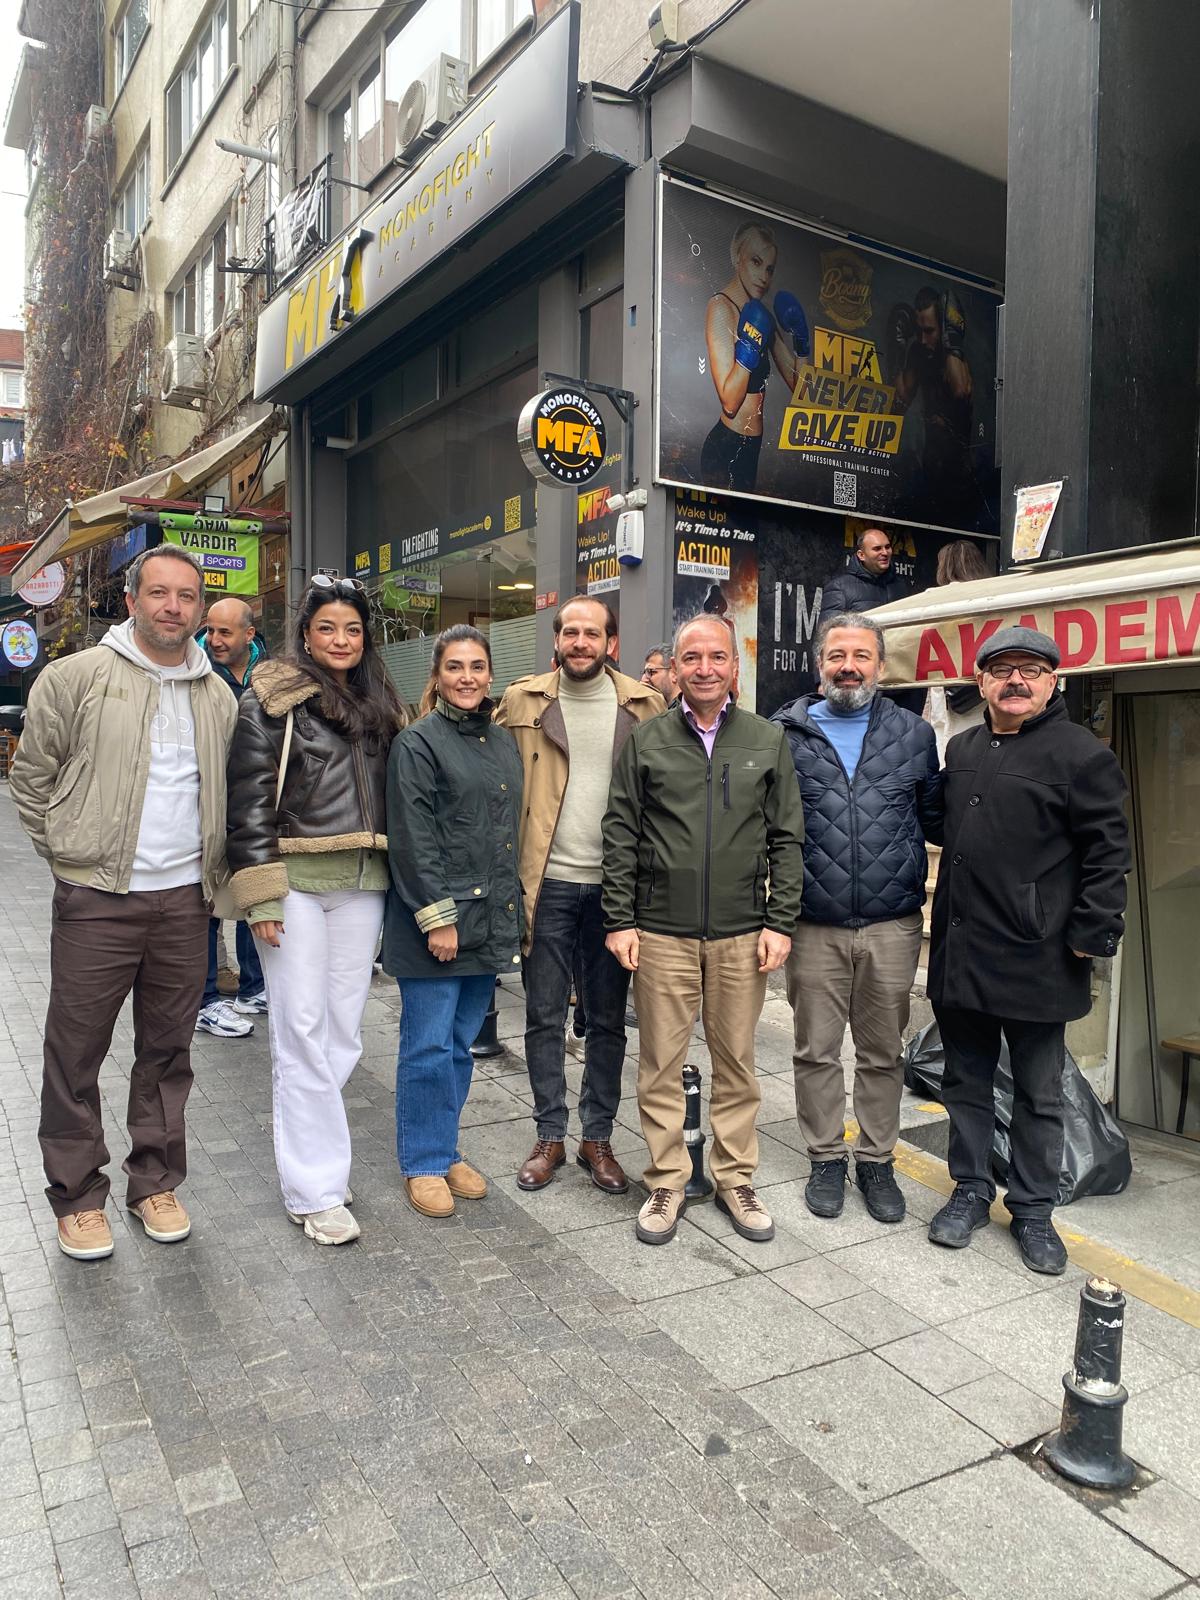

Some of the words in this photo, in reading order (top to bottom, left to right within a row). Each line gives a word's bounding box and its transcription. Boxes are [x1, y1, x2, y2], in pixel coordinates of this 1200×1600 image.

[379, 120, 496, 252] MONOFIGHT
[378, 168, 494, 278] ACADEMY
[743, 321, 763, 346] MFA
[814, 327, 883, 384] MFA
[799, 370, 888, 414] NEVER
[540, 394, 602, 427] MONOFIGHT
[537, 417, 602, 458] MFA
[788, 411, 861, 447] GIVE
[865, 419, 897, 449] UP
[820, 439, 836, 448] TIME
[839, 442, 847, 450] TO
[850, 445, 866, 455] TAKE
[867, 448, 891, 459] ACTION
[544, 453, 595, 478] ACADEMY
[802, 453, 842, 468] PROFESSIONAL
[844, 461, 869, 473] TRAINING
[870, 466, 890, 477] CENTER
[677, 504, 706, 519] Wake
[709, 509, 727, 524] Up!
[180, 531, 237, 552] VARDIR
[412, 528, 439, 553] FIGHTING
[578, 533, 596, 548] Wake
[598, 529, 610, 545] Up!
[675, 521, 692, 533] It's
[694, 523, 718, 536] Time
[720, 528, 730, 538] to
[733, 529, 755, 542] Take
[206, 556, 243, 568] SPORTS
[578, 551, 589, 562] It's
[590, 546, 607, 560] Time
[608, 544, 616, 555] to
[678, 541, 731, 567] ACTION
[679, 564, 692, 572] START
[693, 565, 714, 575] TRAINING
[715, 567, 729, 576] TODAY
[774, 581, 823, 644] I'M
[773, 649, 796, 672] FOR
[801, 651, 809, 673] A
